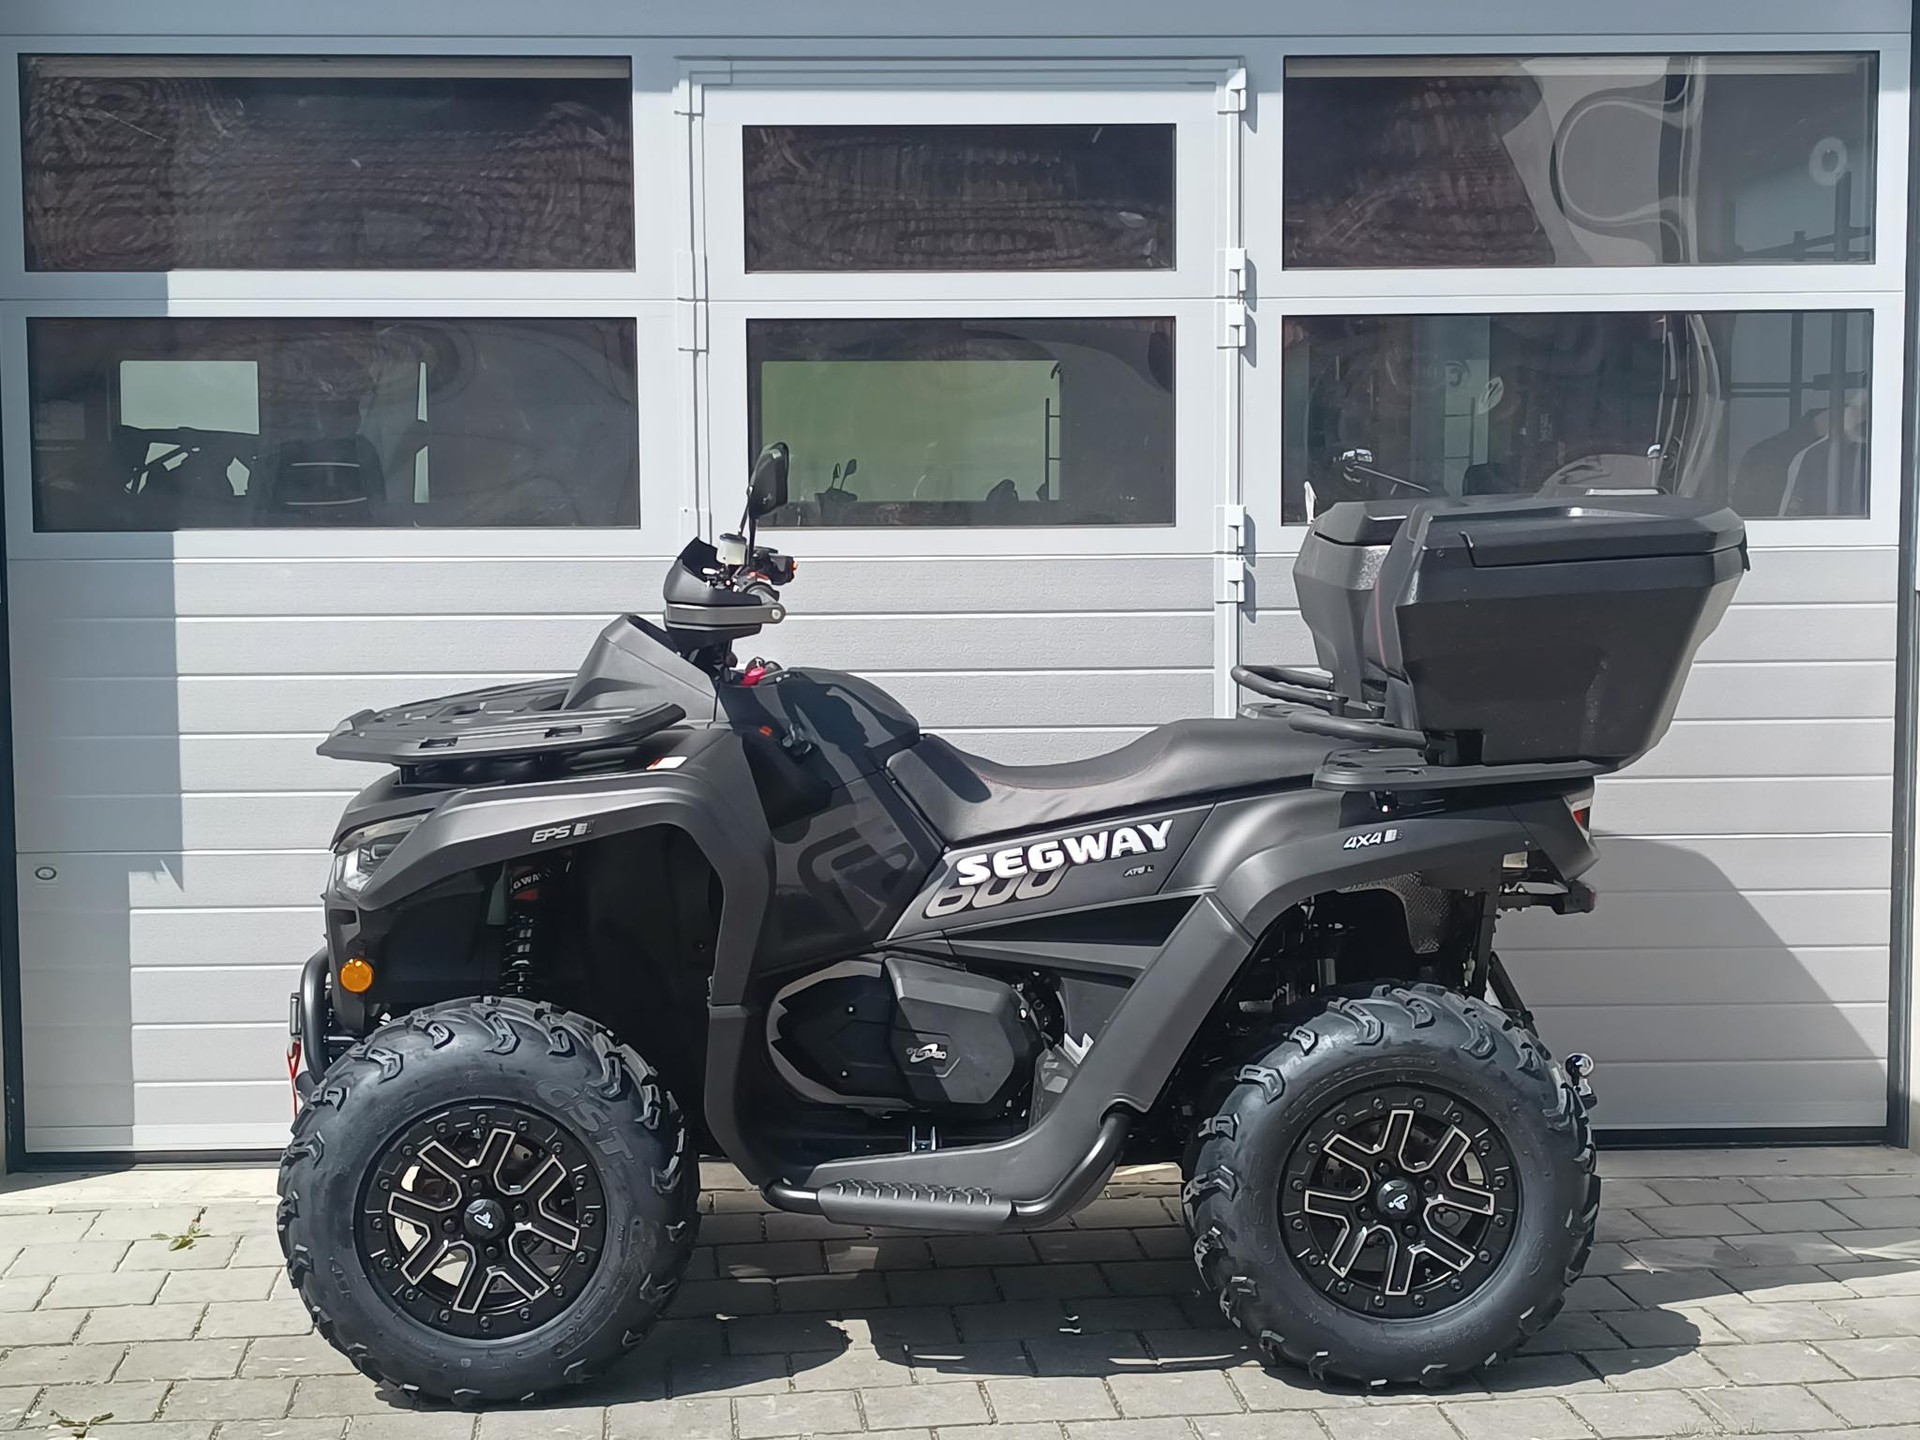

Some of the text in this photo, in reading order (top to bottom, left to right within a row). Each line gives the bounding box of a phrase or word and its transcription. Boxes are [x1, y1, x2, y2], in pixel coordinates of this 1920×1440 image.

[531, 824, 572, 844] EPS
[956, 819, 1173, 886] SEGWAY
[535, 1080, 634, 1163] CST
